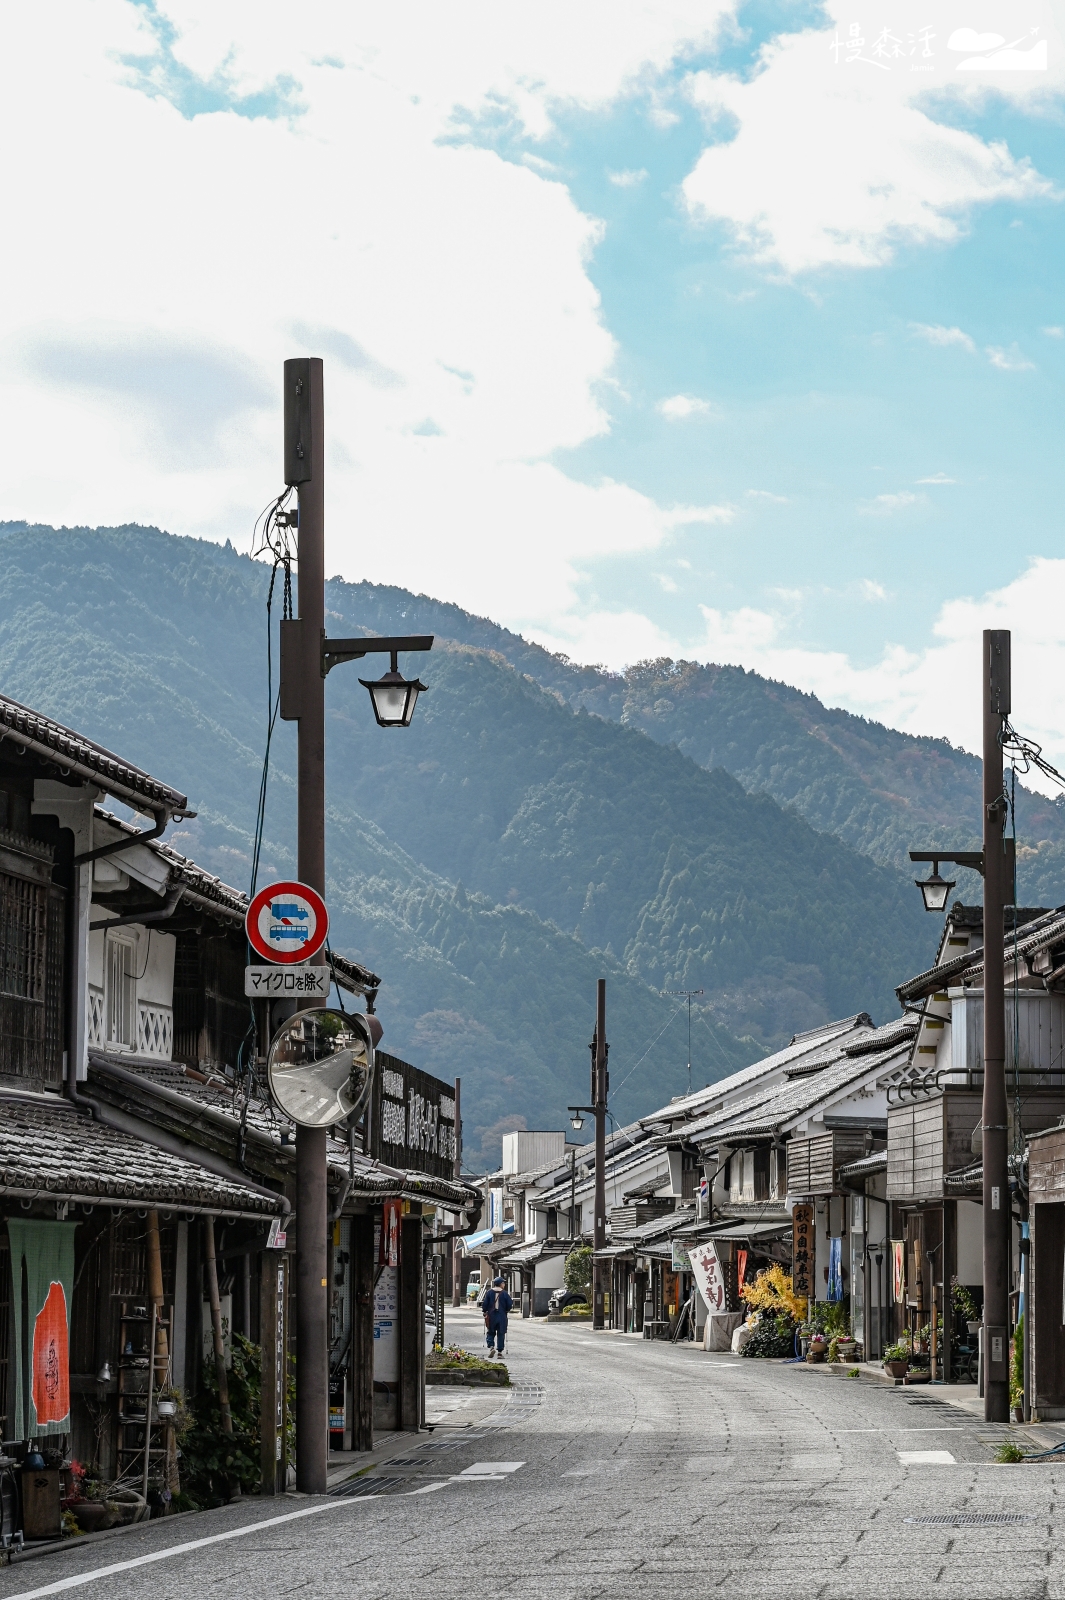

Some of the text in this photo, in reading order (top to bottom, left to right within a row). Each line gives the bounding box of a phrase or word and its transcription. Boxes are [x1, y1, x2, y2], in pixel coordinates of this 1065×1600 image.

[251, 973, 323, 991] マイクロを除く
